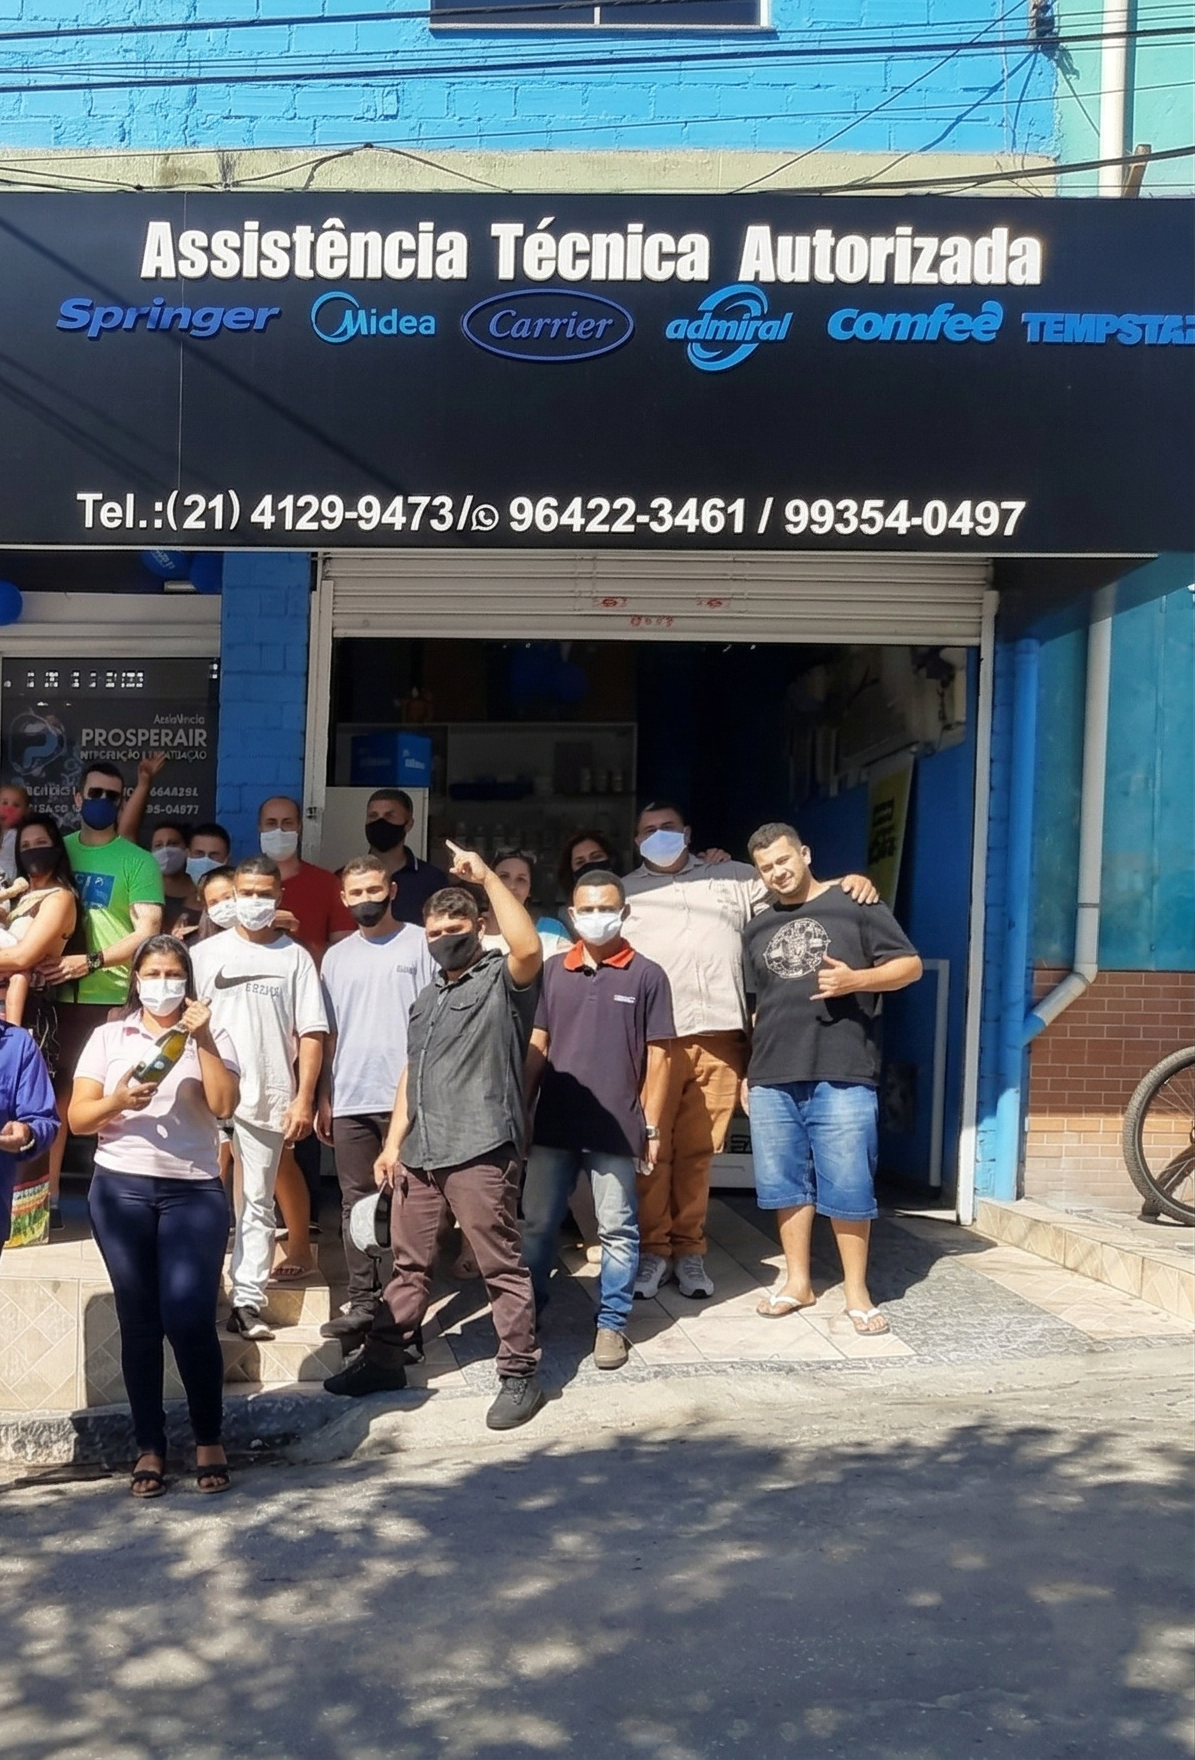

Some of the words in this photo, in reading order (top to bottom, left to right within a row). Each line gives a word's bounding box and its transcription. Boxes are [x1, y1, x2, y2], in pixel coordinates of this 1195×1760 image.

[140, 217, 467, 280] Assistência
[490, 216, 710, 281] Técnica
[738, 224, 1043, 285] Autorizada
[56, 297, 281, 338] Springer
[323, 300, 436, 339] Midea
[488, 308, 614, 340] Carrier
[665, 311, 794, 341] admiral
[509, 496, 745, 534] 96422-3461
[784, 498, 1027, 536] 99354-0497
[81, 728, 207, 747] PROSPERAIR
